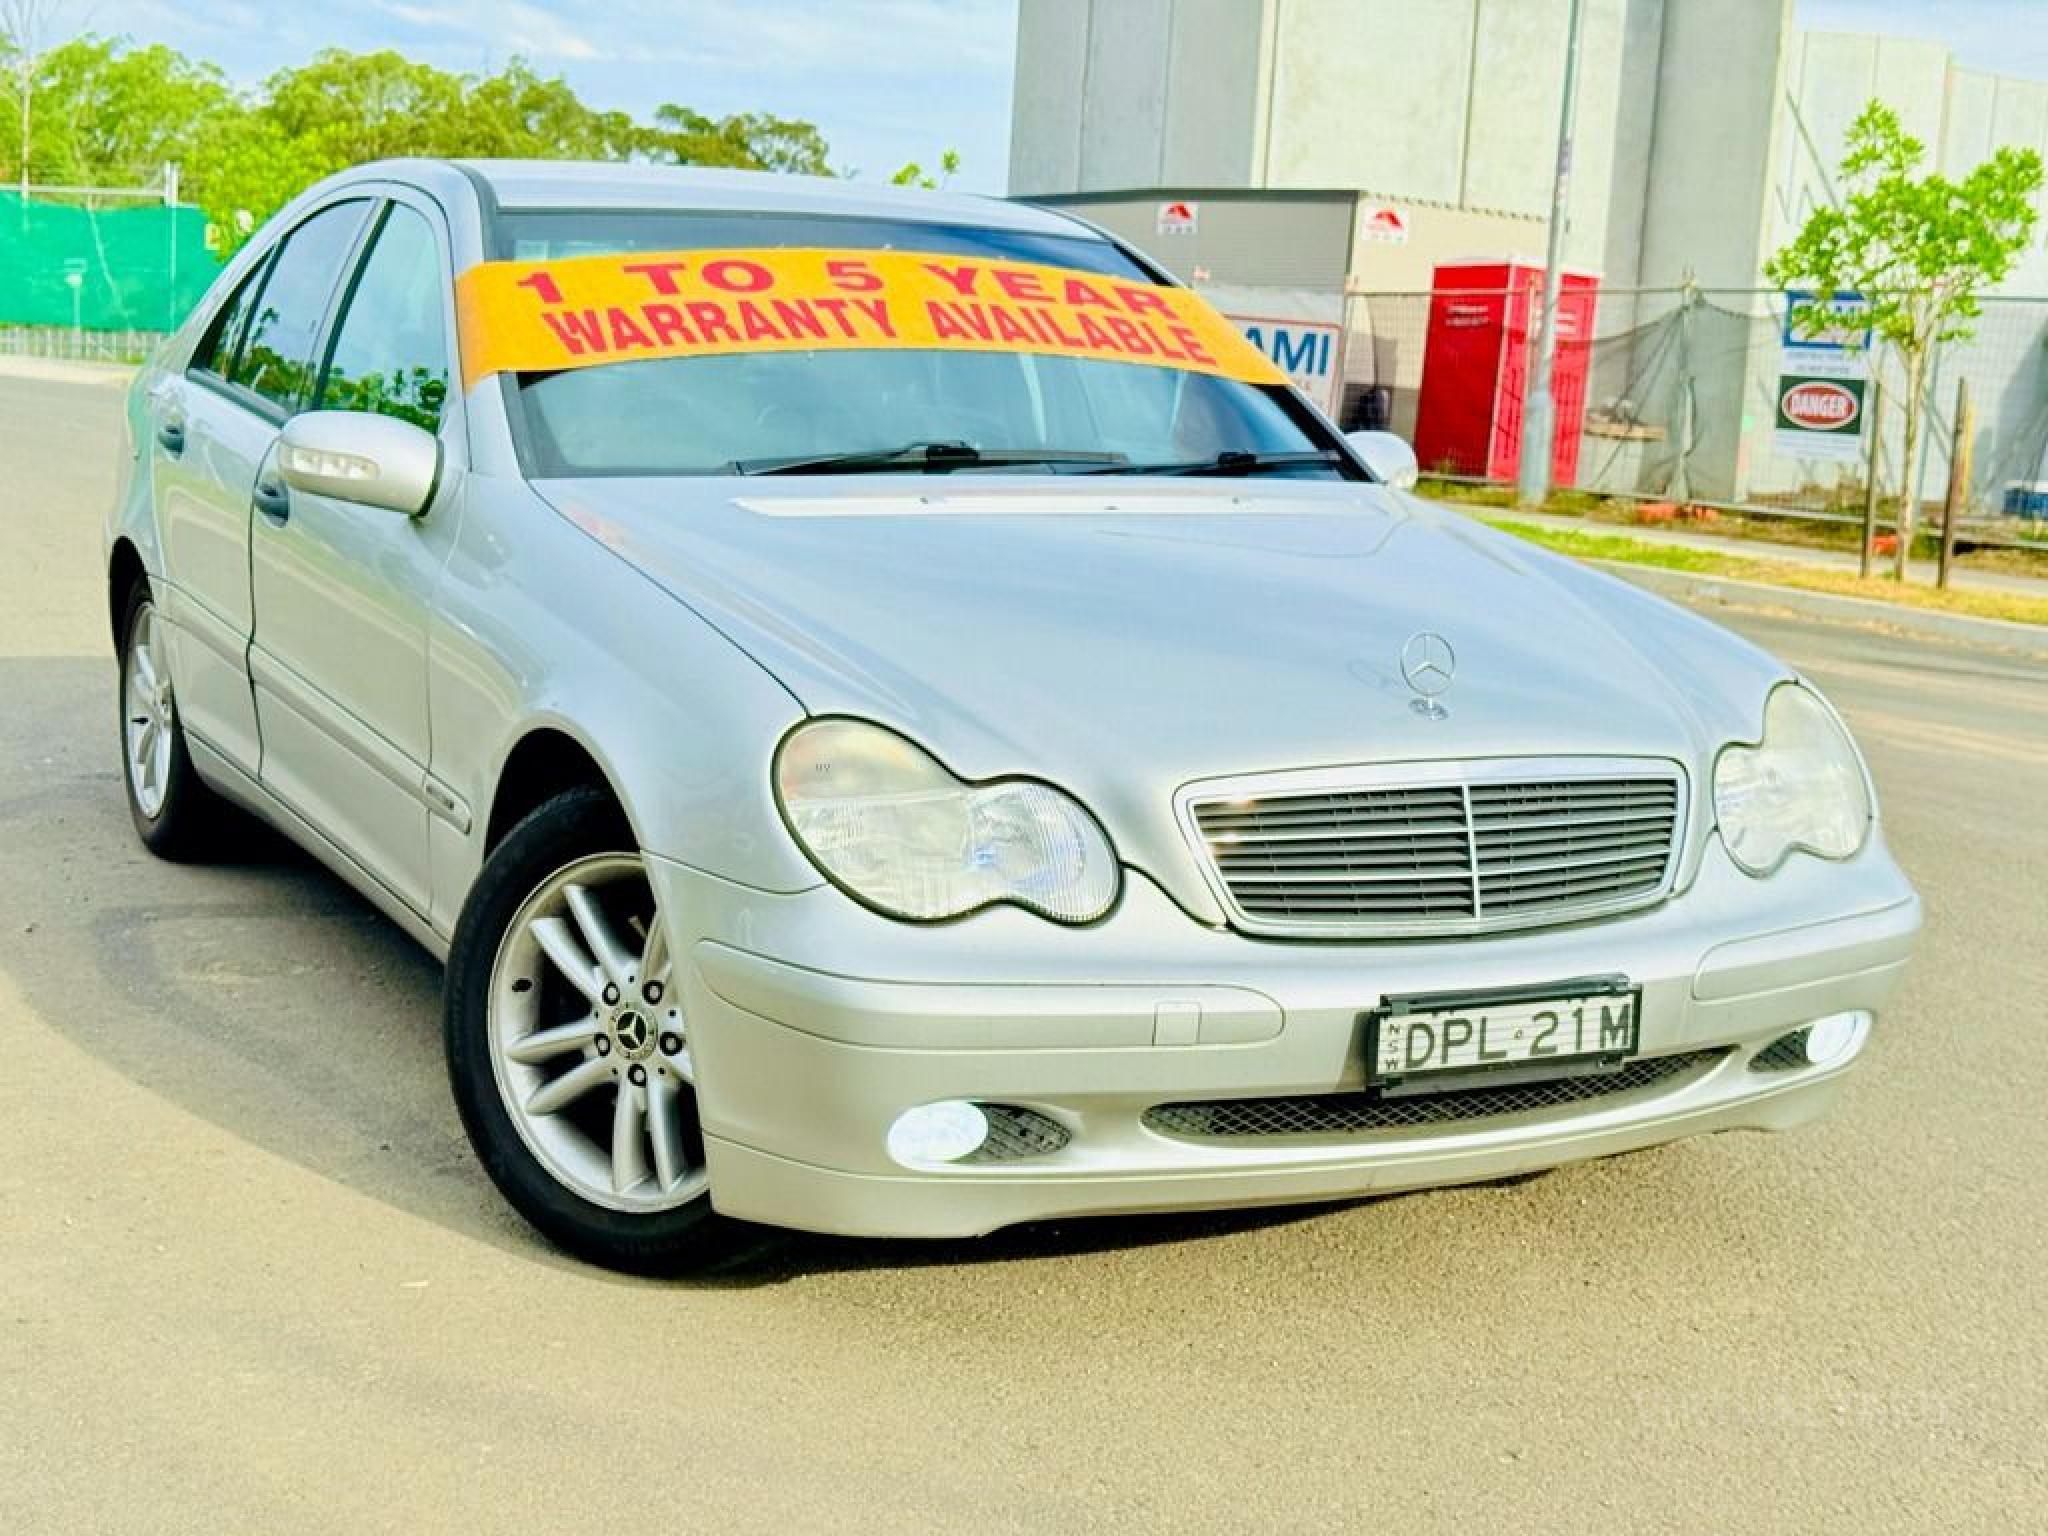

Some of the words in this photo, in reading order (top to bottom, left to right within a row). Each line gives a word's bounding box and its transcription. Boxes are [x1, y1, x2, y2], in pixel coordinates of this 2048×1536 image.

[517, 272, 562, 303] 1
[623, 260, 774, 294] TO
[826, 261, 884, 292] 5
[922, 264, 1180, 320] YEAR
[542, 300, 897, 355] WARRANTY
[926, 301, 1217, 366] AVAILABLE
[1405, 1016, 1507, 1069] DPL
[1530, 1003, 1631, 1057] 21M
